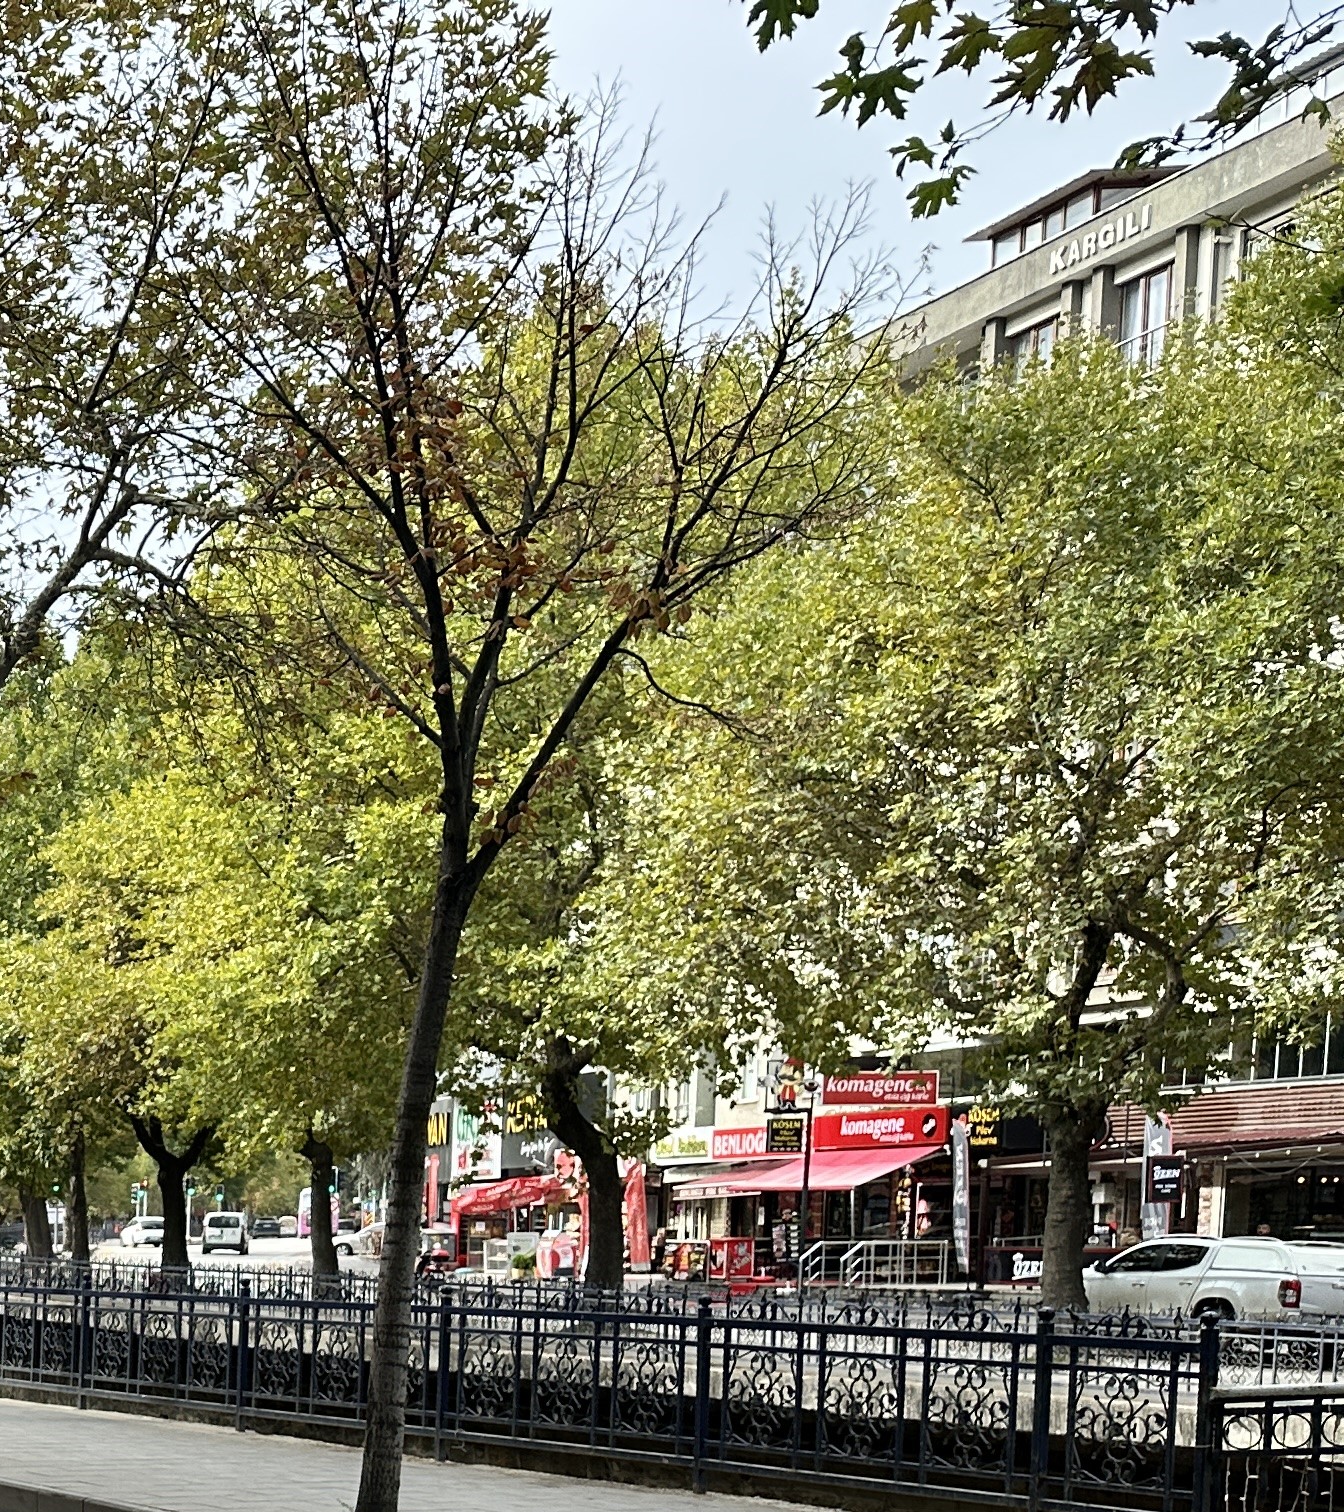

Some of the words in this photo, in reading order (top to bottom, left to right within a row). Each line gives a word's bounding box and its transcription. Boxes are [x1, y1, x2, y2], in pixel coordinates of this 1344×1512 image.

[1049, 203, 1153, 275] KARGILI
[428, 1111, 448, 1146] VAN
[714, 1129, 768, 1157] BENLIOĞ
[840, 1115, 905, 1140] komagene
